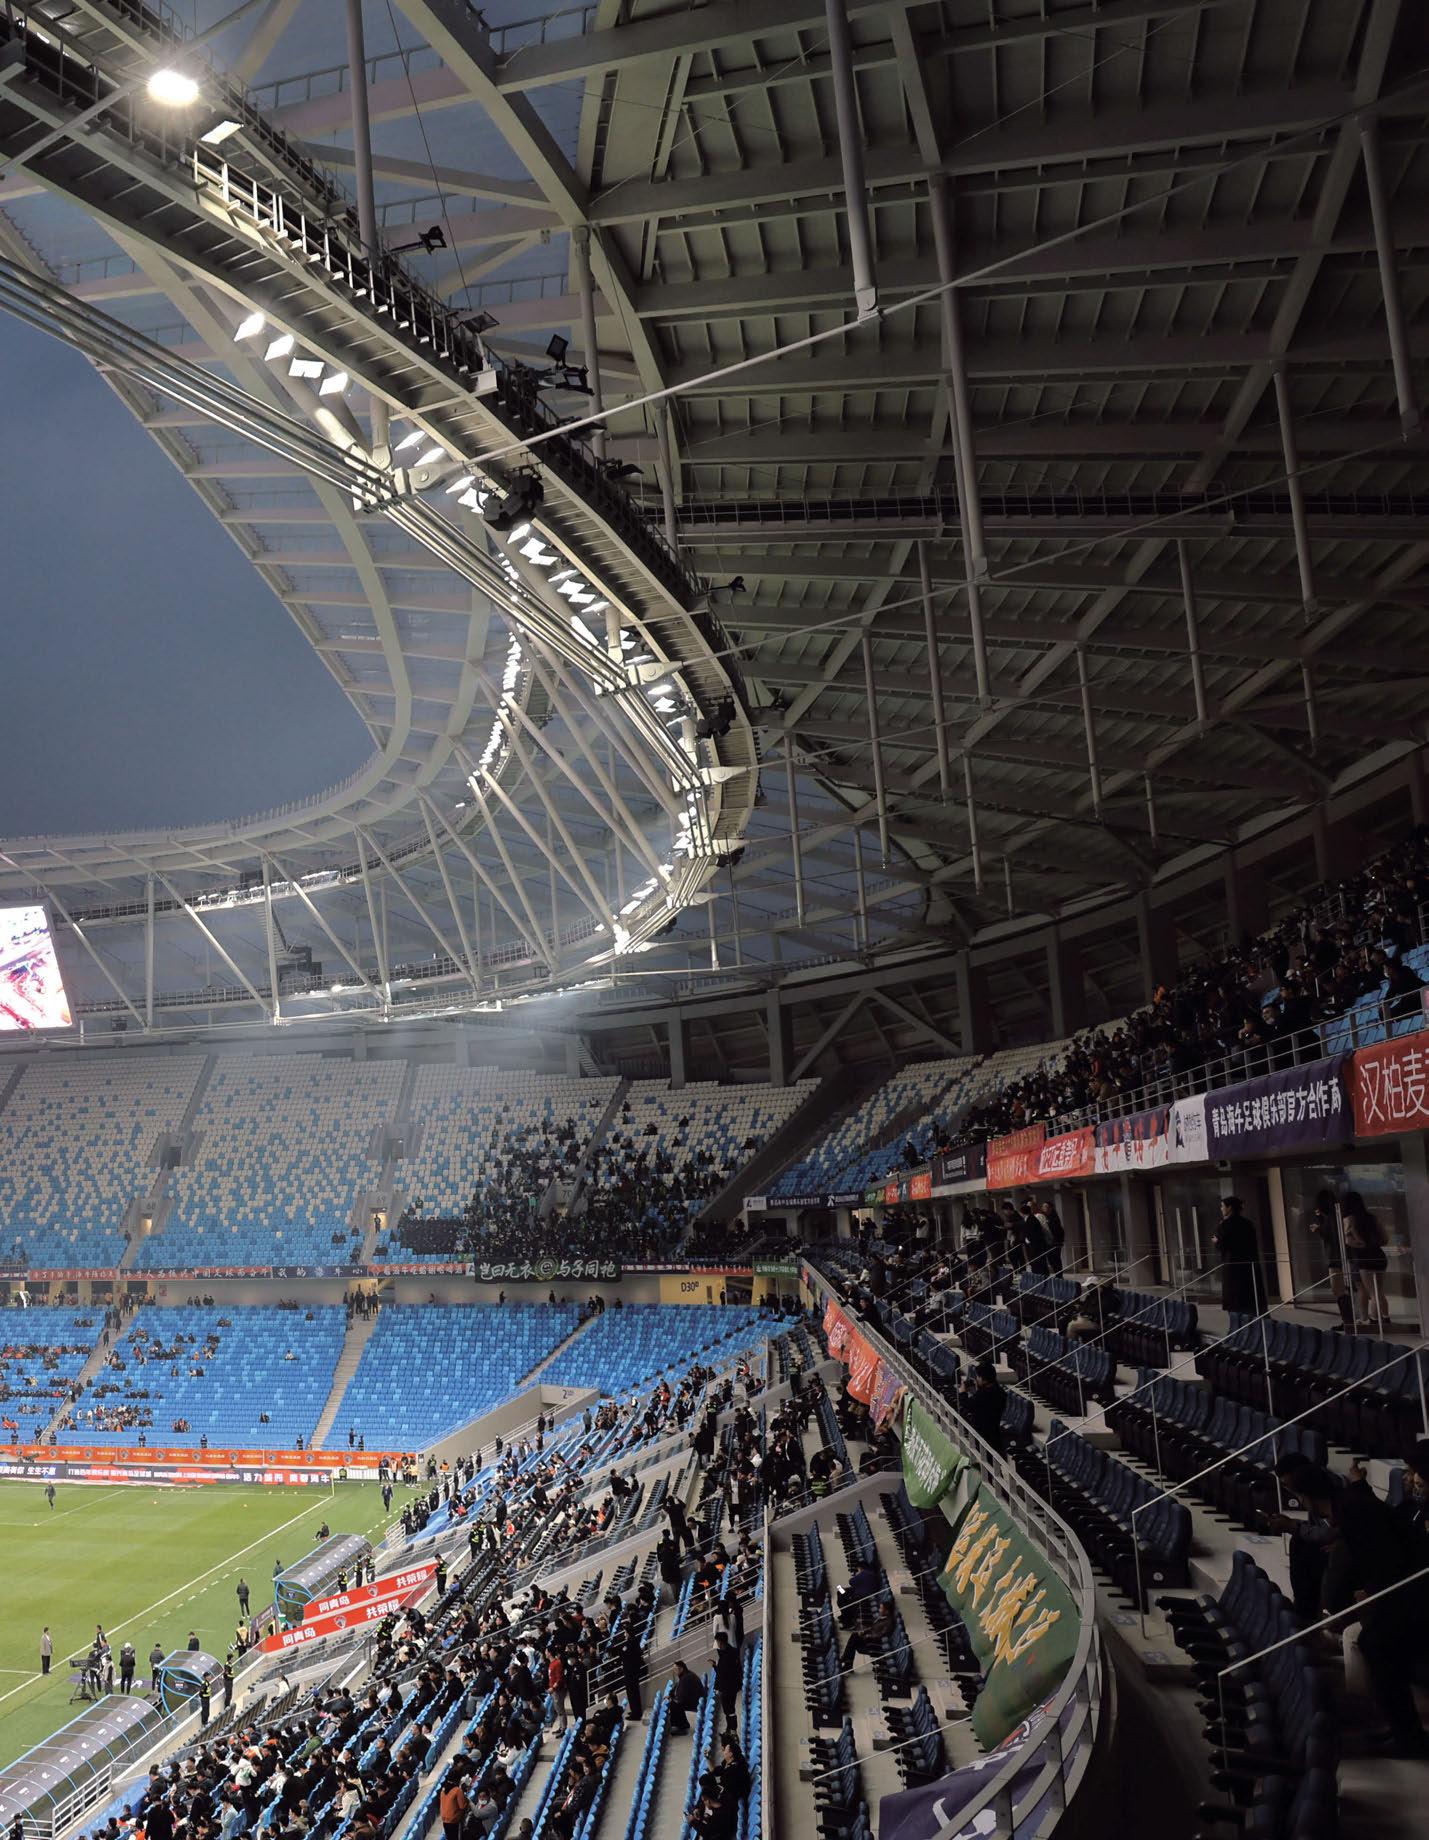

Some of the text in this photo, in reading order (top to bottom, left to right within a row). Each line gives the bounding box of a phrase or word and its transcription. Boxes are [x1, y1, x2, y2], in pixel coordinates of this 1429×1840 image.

[1211, 1075, 1342, 1139] 青岛海牛足球俱乐部官方合作商
[1359, 1048, 1429, 1125] 汉柏麦
[480, 1259, 617, 1280] 岂曰无衣 与子同袍
[395, 1569, 429, 1589] 共荣耀
